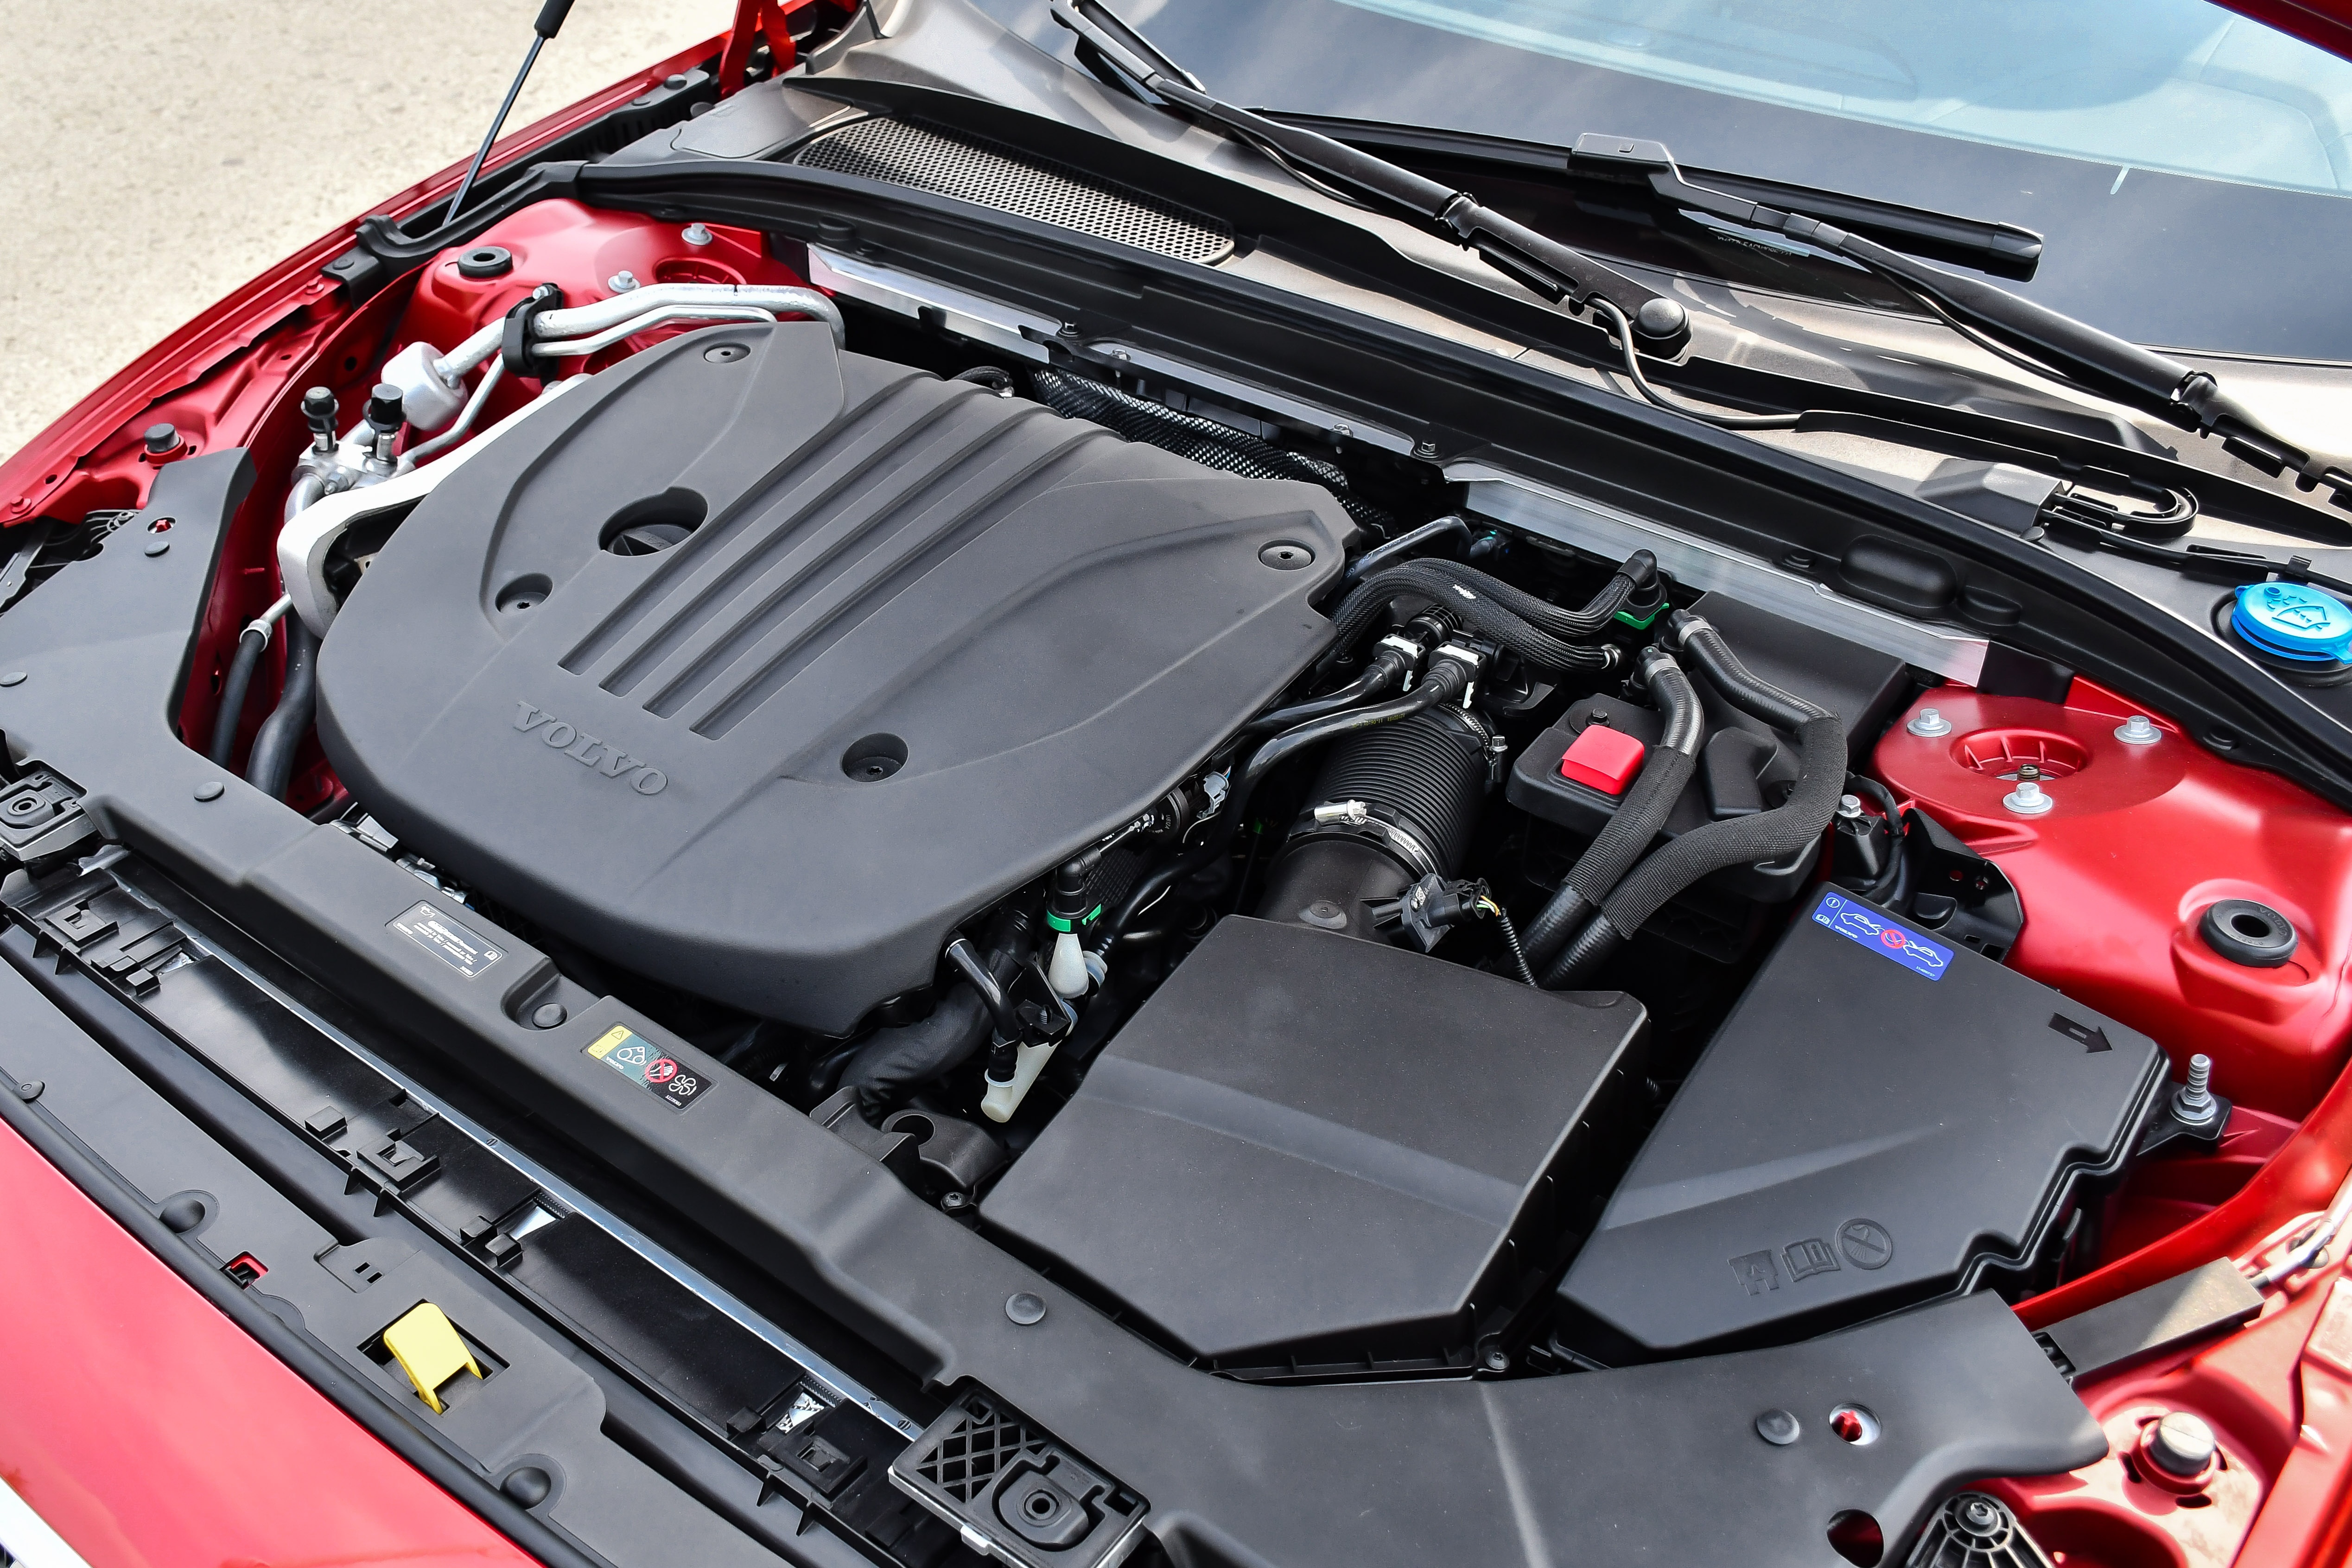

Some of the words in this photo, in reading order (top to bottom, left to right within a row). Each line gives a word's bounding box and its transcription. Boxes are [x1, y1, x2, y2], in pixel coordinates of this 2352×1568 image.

[513, 700, 668, 796] VOLVO
[1834, 925, 1858, 939] VOLVO
[606, 1056, 624, 1070] VOLVO
